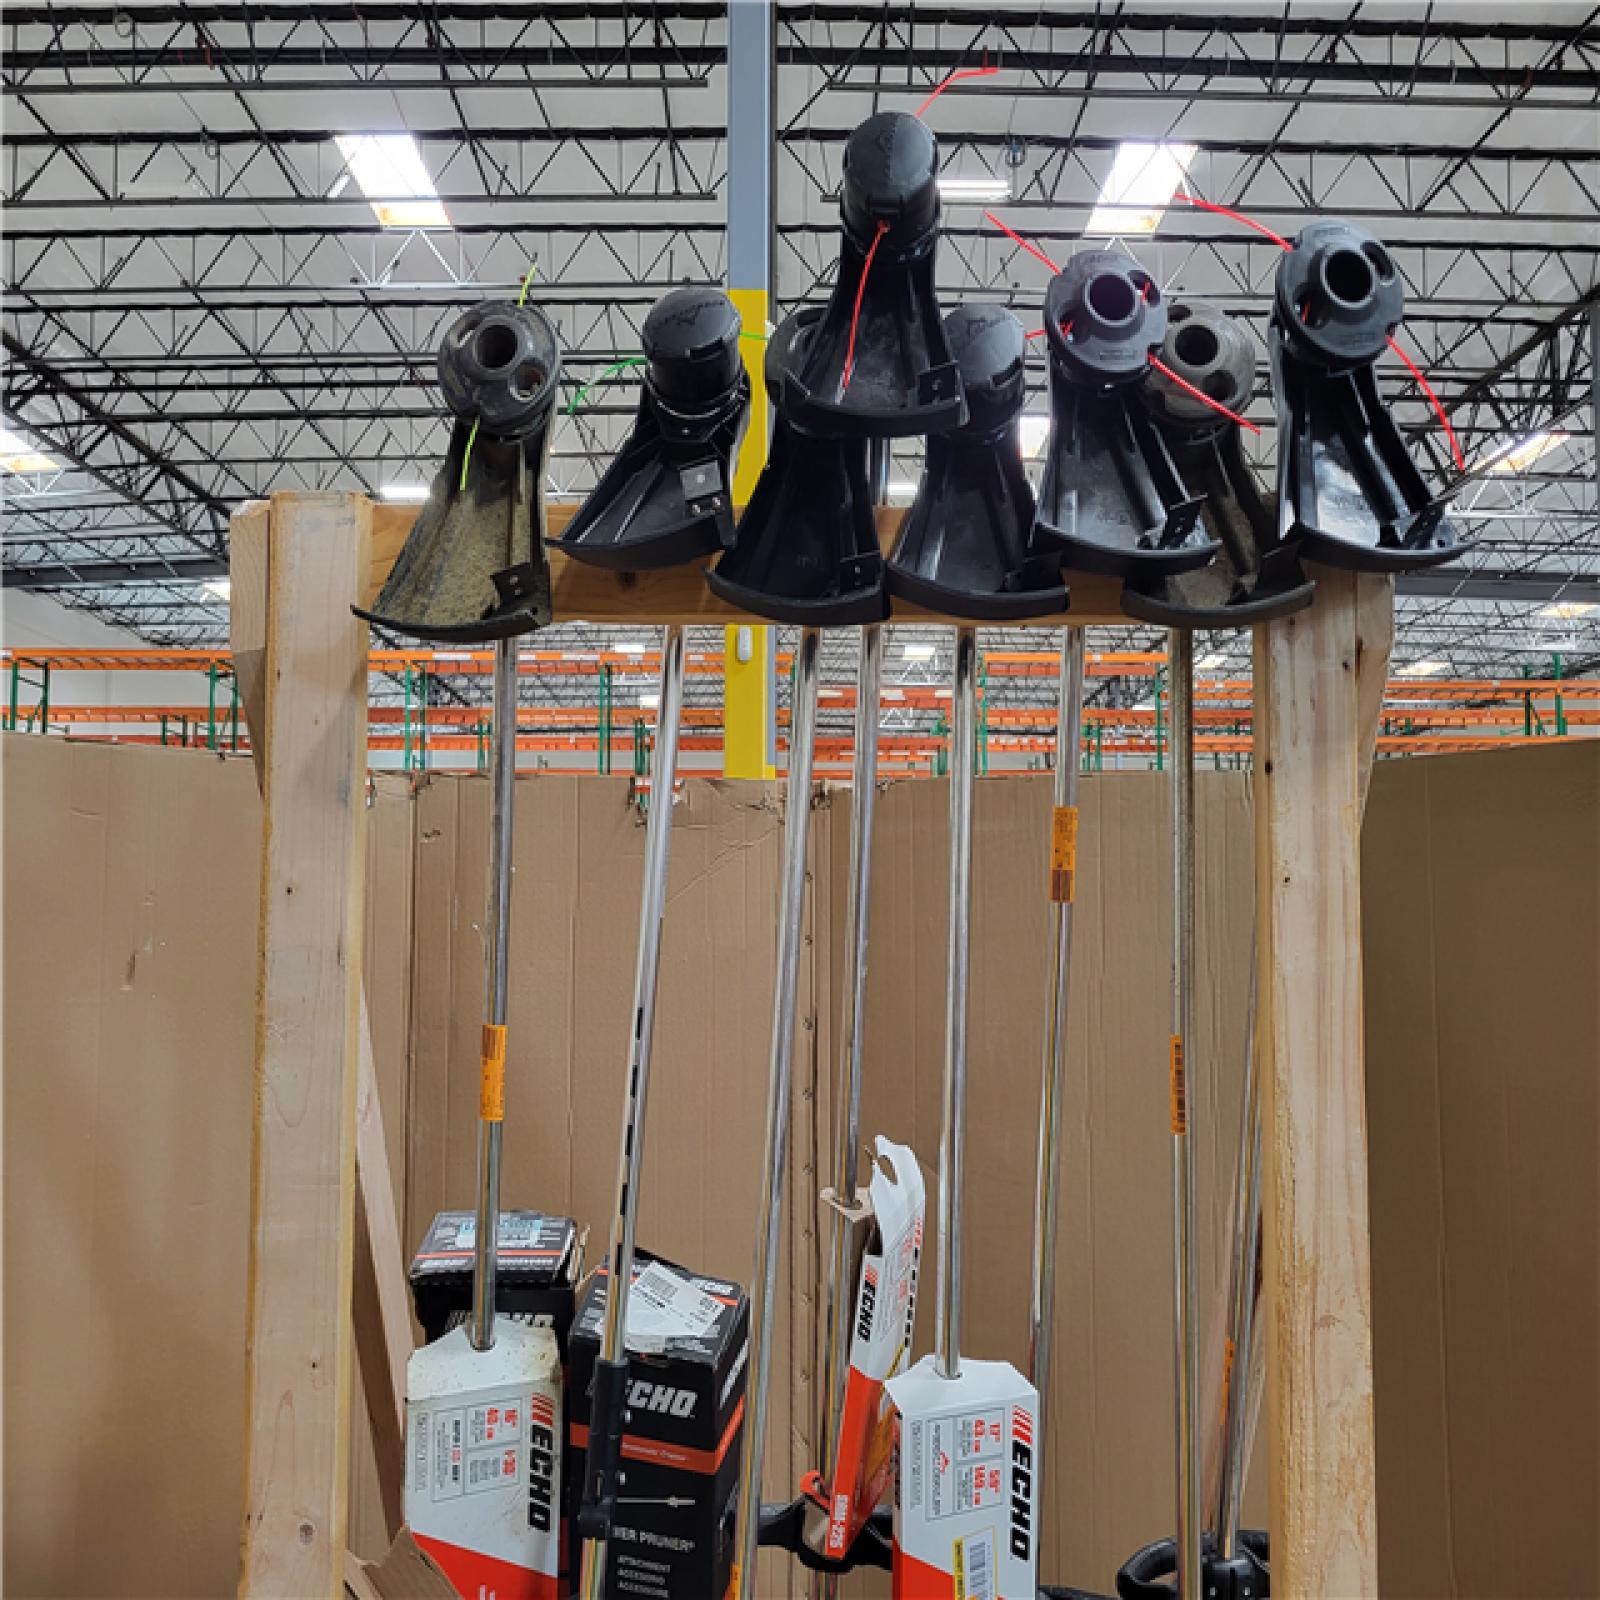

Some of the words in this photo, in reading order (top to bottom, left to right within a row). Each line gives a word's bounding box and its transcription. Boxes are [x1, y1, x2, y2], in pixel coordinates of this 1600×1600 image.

[857, 1279, 876, 1343] ECHO
[625, 1379, 698, 1418] CHO
[529, 1424, 553, 1533] ECHO
[1010, 1440, 1033, 1562] ECHO
